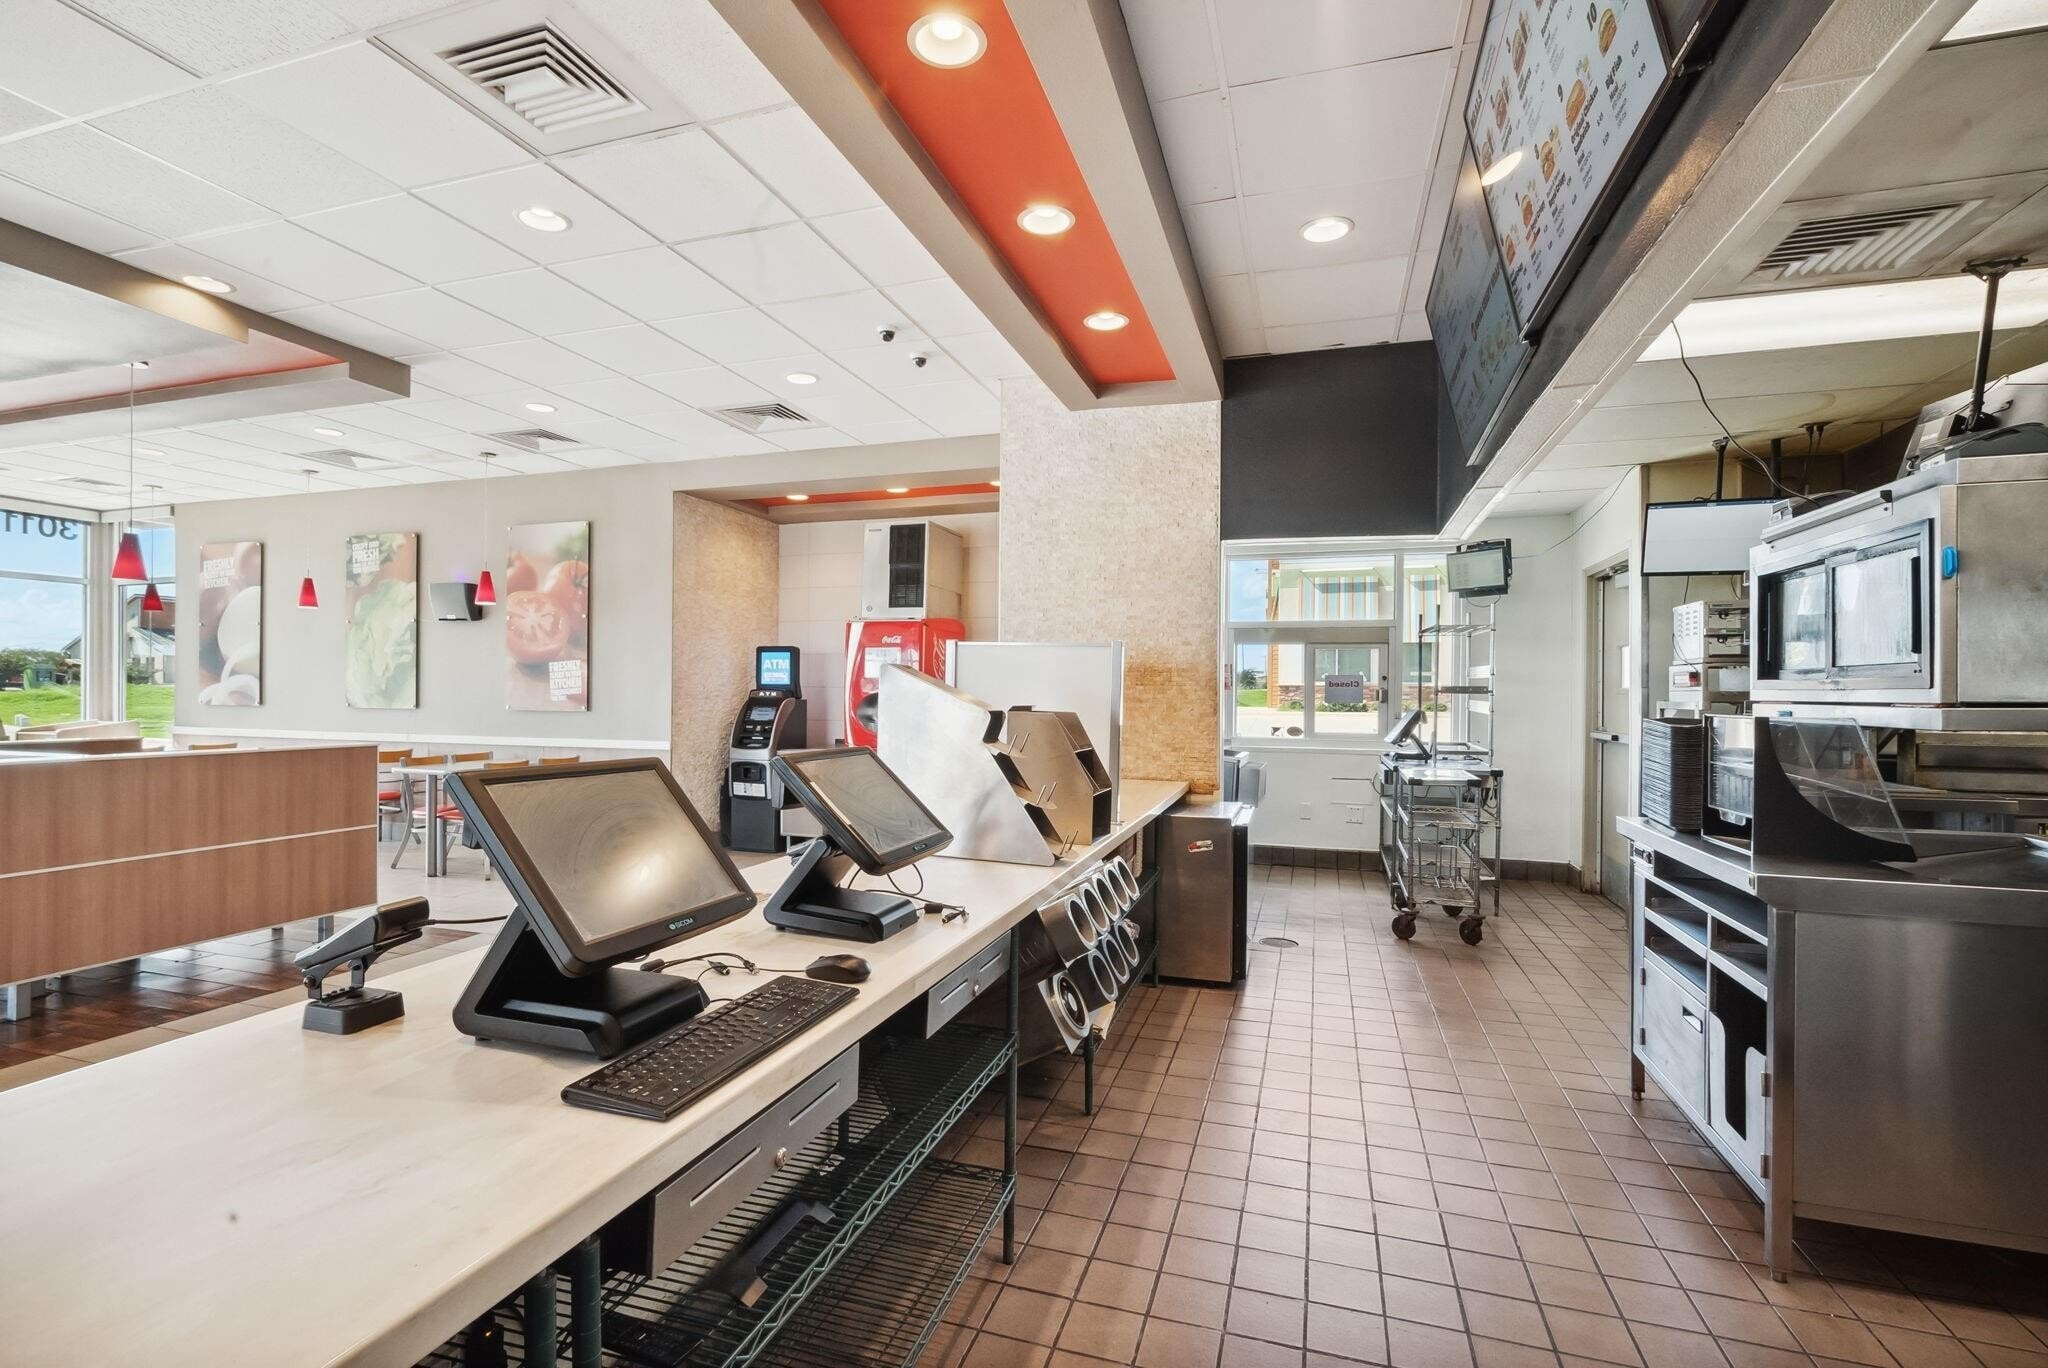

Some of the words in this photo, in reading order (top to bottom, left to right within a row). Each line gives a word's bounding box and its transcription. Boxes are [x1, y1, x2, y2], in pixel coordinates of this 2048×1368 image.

[1586, 2, 1597, 31] 10
[1604, 71, 1614, 90] Big
[1612, 54, 1622, 77] Fish
[1570, 112, 1585, 145] Original
[1583, 85, 1599, 117] Chicken
[1573, 121, 1591, 156] Sandwich
[352, 548, 380, 563] FRESH
[203, 558, 234, 577] FRESHLY
[548, 660, 581, 673] FRESHLY
[763, 659, 790, 670] ATM
[550, 677, 582, 689] KITCHEN
[675, 917, 694, 929] SICOM
